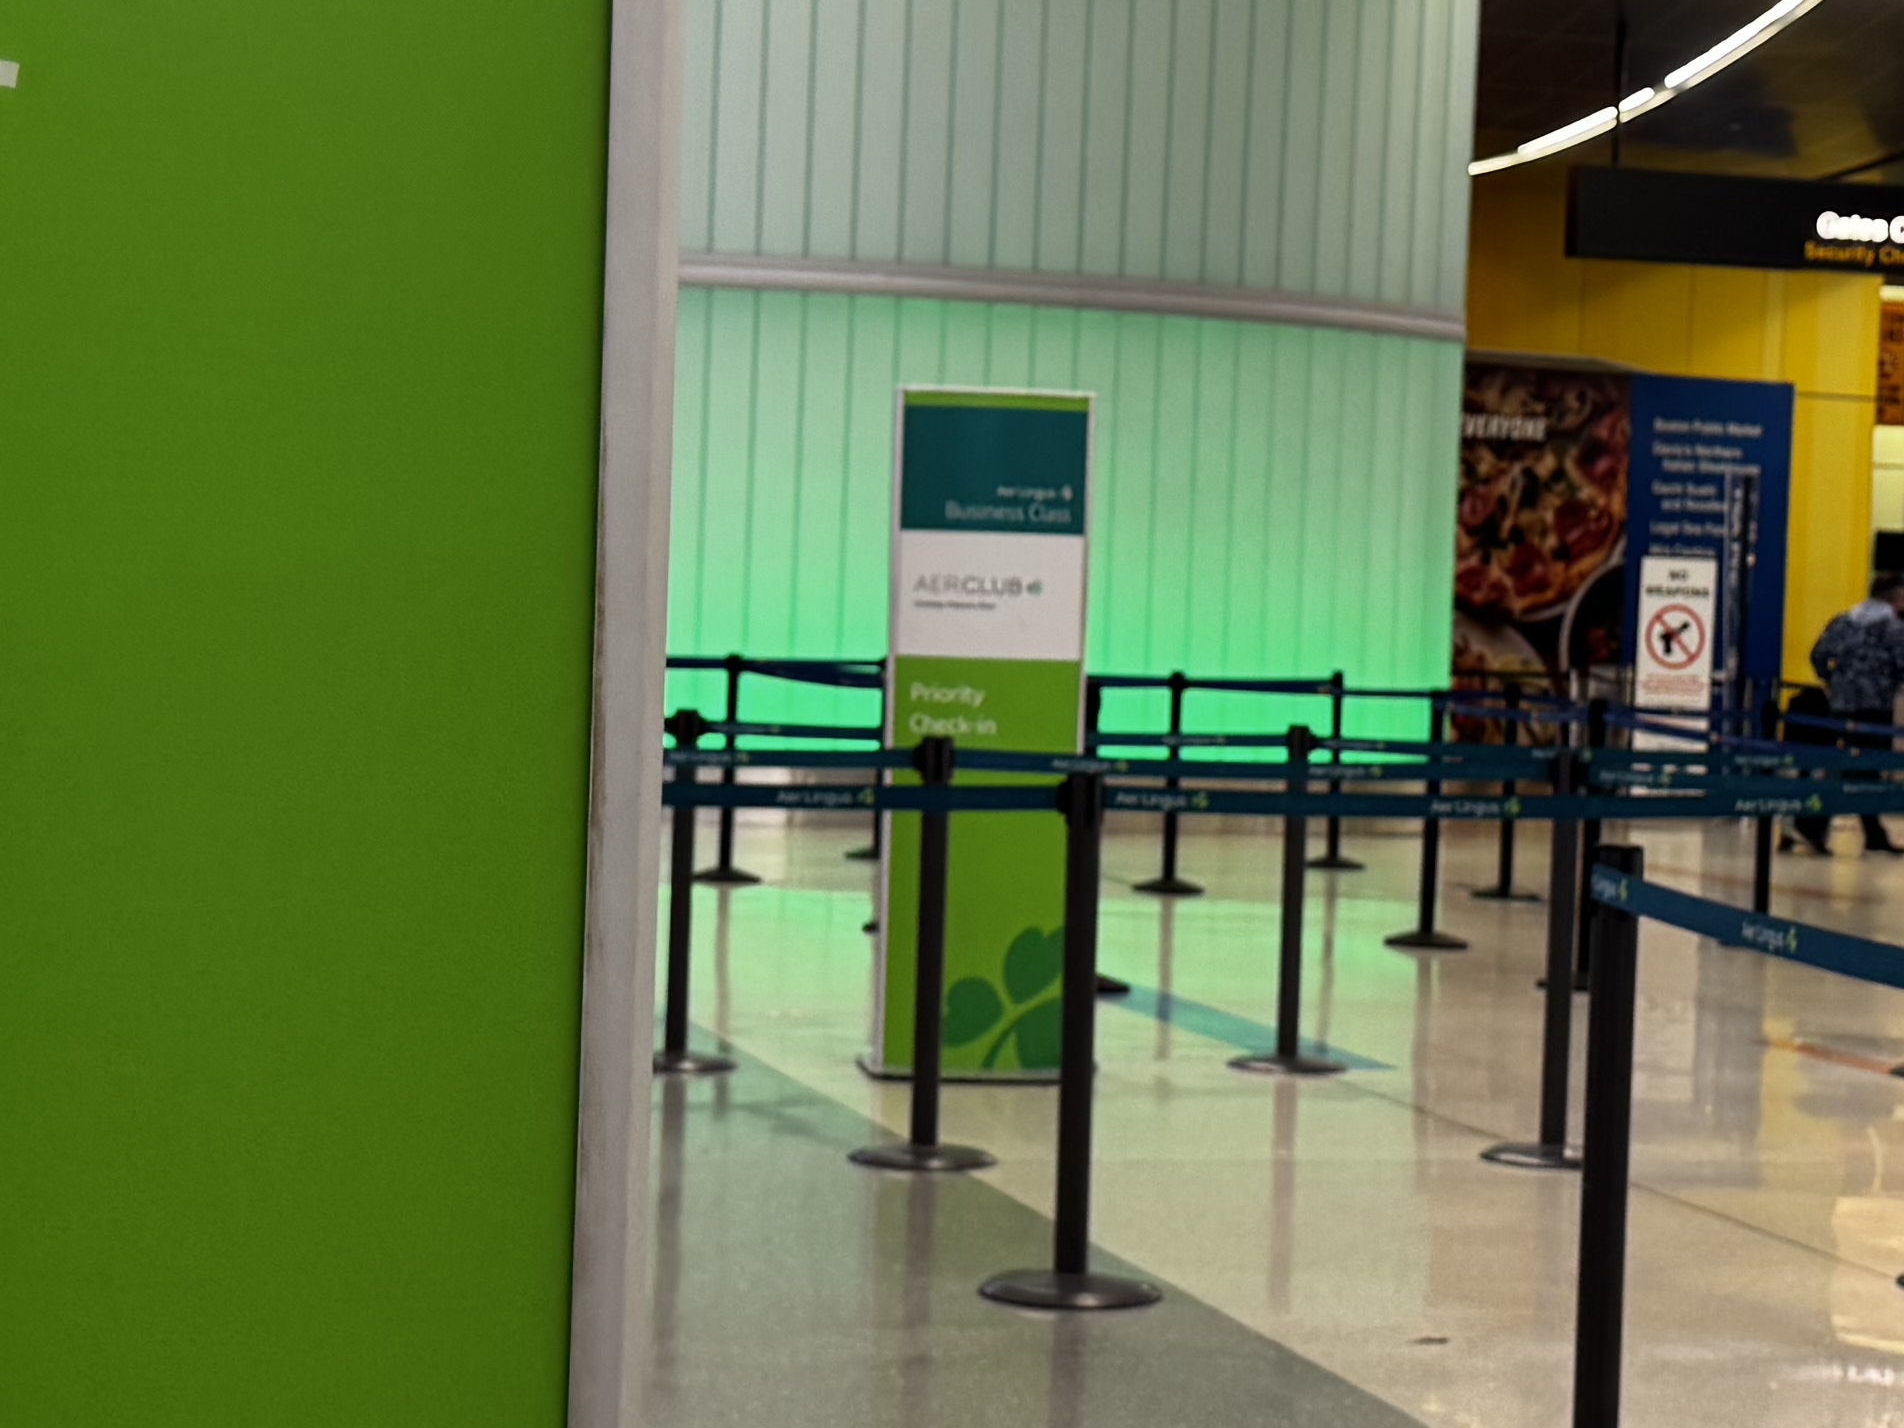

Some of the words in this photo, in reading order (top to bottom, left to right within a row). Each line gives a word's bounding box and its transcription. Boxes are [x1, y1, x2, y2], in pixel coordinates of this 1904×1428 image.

[945, 500, 1025, 521] Business
[1028, 502, 1073, 523] Class
[909, 681, 986, 708] Priority
[909, 712, 998, 736] Check-in
